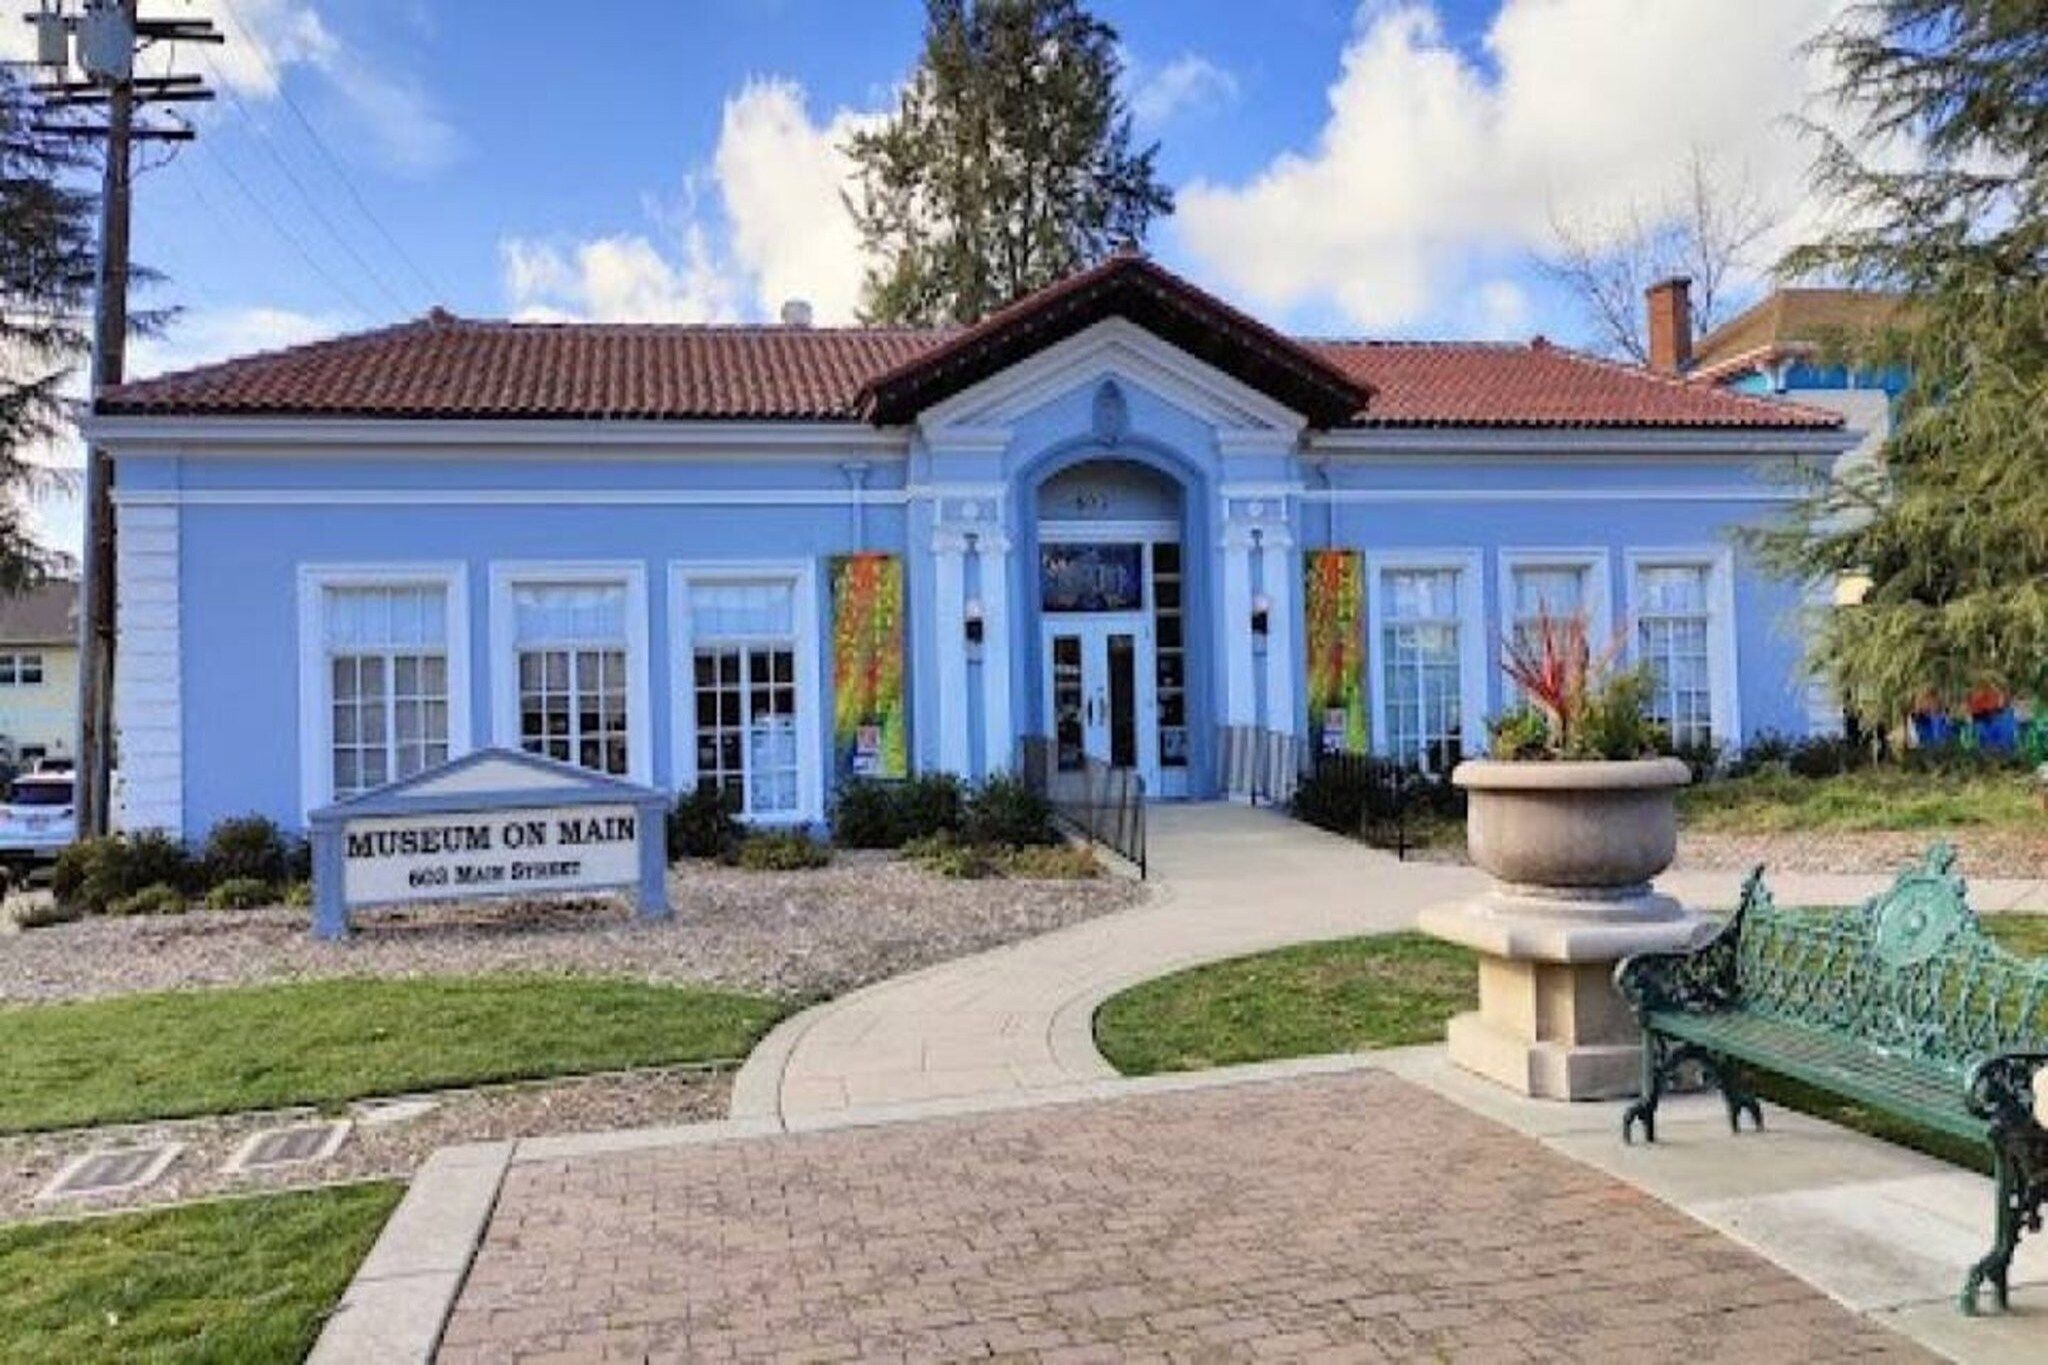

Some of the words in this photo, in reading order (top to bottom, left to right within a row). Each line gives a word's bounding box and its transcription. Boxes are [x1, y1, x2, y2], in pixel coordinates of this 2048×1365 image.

[347, 826, 490, 858] MUSEUM
[503, 822, 546, 849] ON
[558, 817, 634, 845] MAIN
